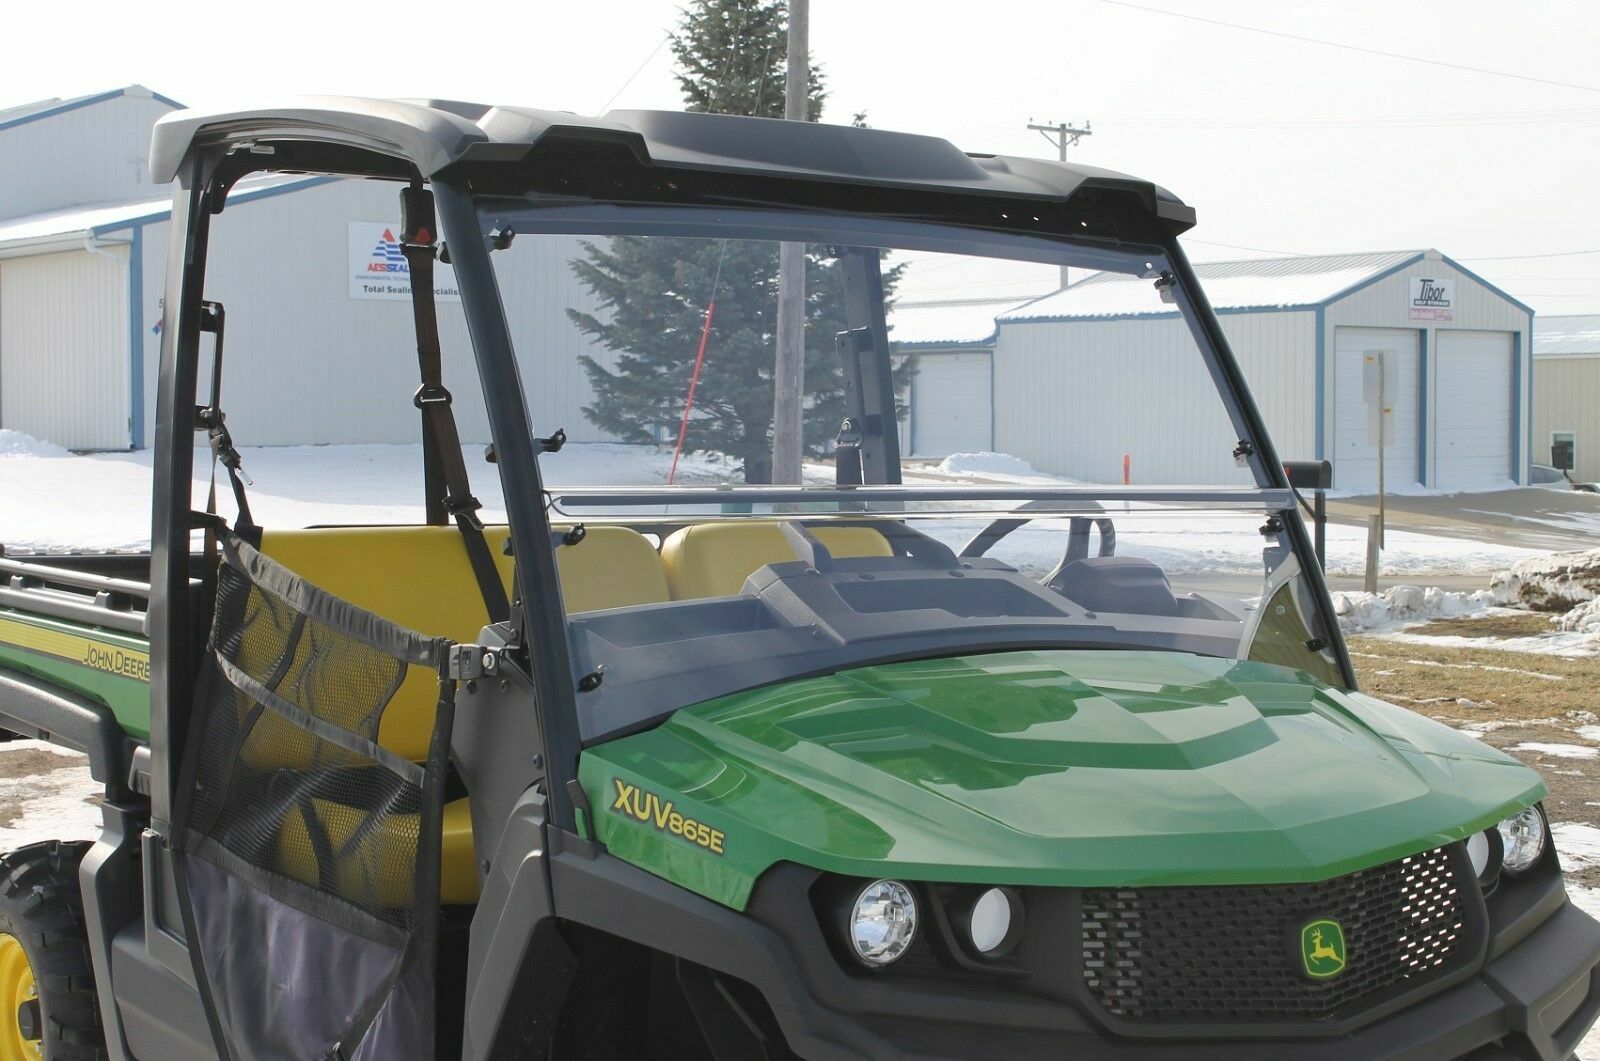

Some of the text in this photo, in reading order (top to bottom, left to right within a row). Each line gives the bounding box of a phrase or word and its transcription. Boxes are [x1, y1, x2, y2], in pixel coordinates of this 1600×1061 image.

[363, 285, 385, 293] Total
[387, 285, 412, 294] Sealin
[1420, 279, 1445, 301] Tibor
[83, 643, 150, 678] JOHN DEERE
[613, 777, 725, 855] XUV865E
